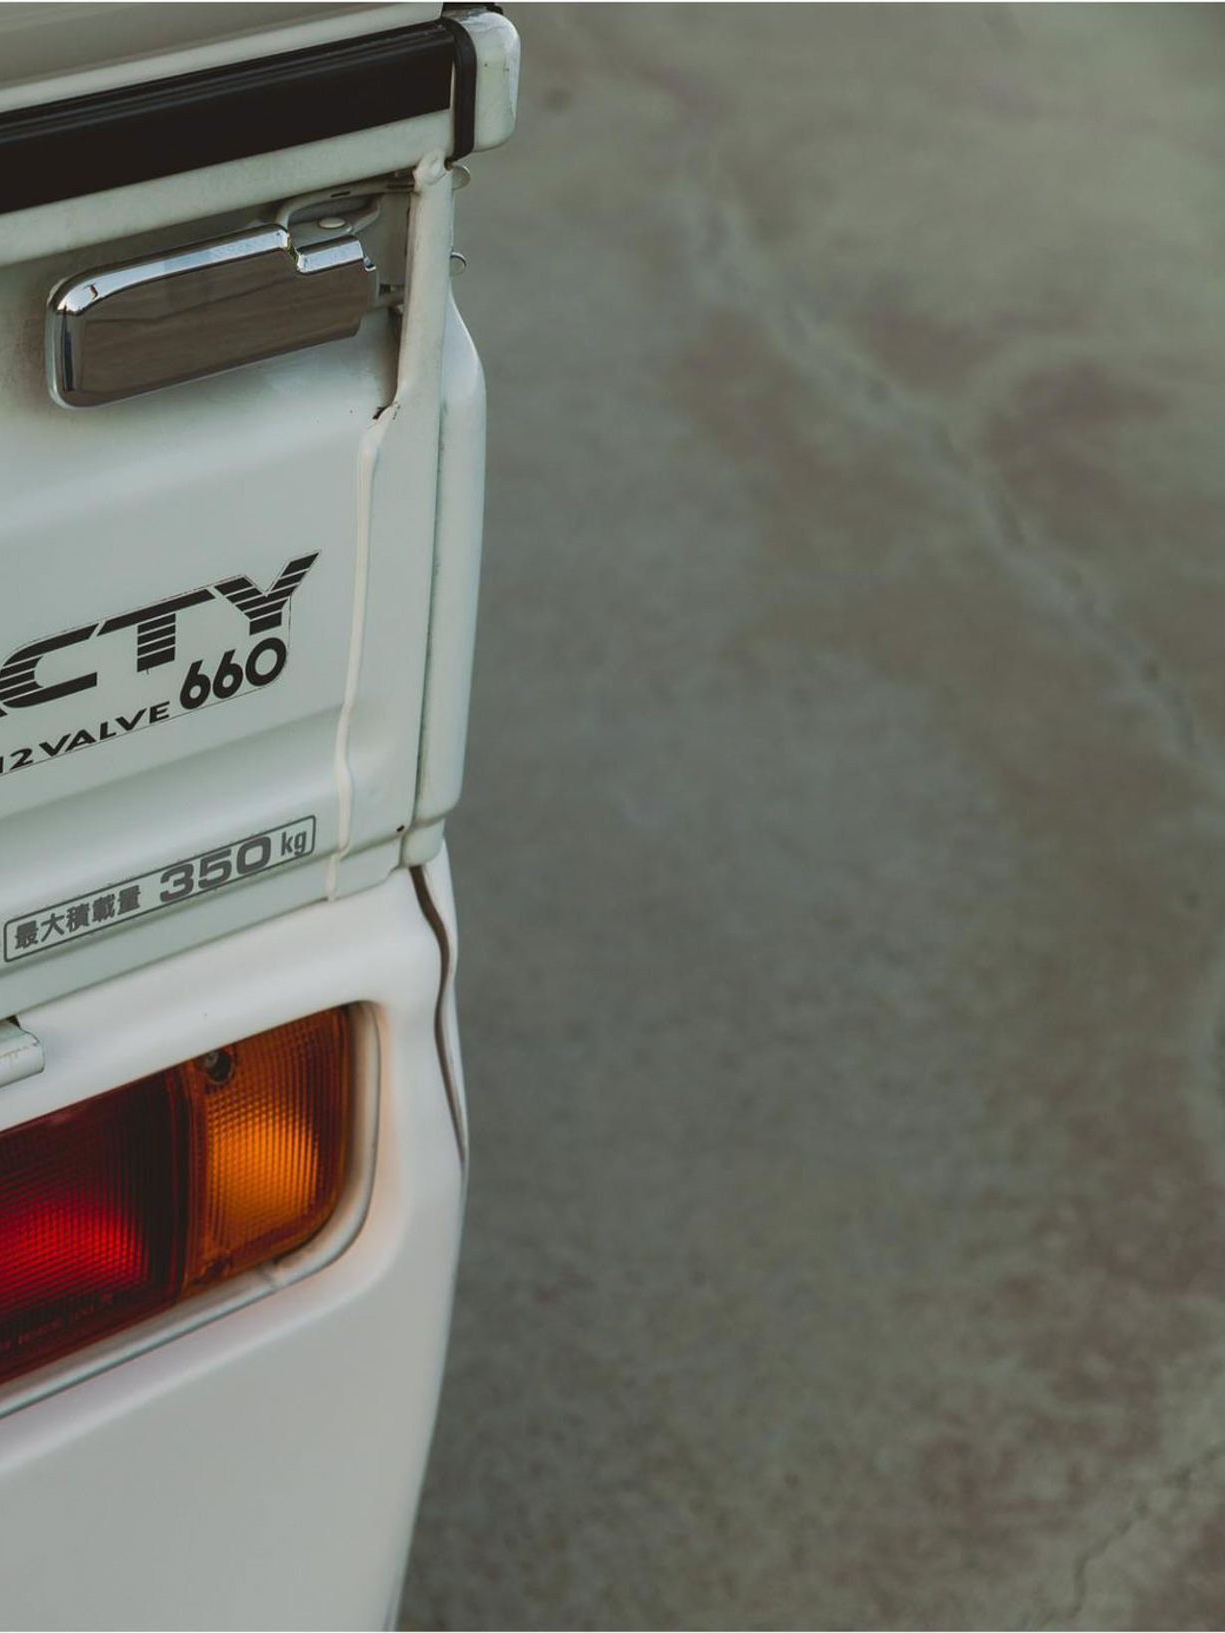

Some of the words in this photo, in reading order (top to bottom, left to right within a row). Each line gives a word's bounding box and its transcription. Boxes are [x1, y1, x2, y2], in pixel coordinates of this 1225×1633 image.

[179, 635, 288, 711] 660
[14, 885, 141, 950] 最大積載量
[159, 835, 272, 903] 350
[280, 829, 307, 857] kg
